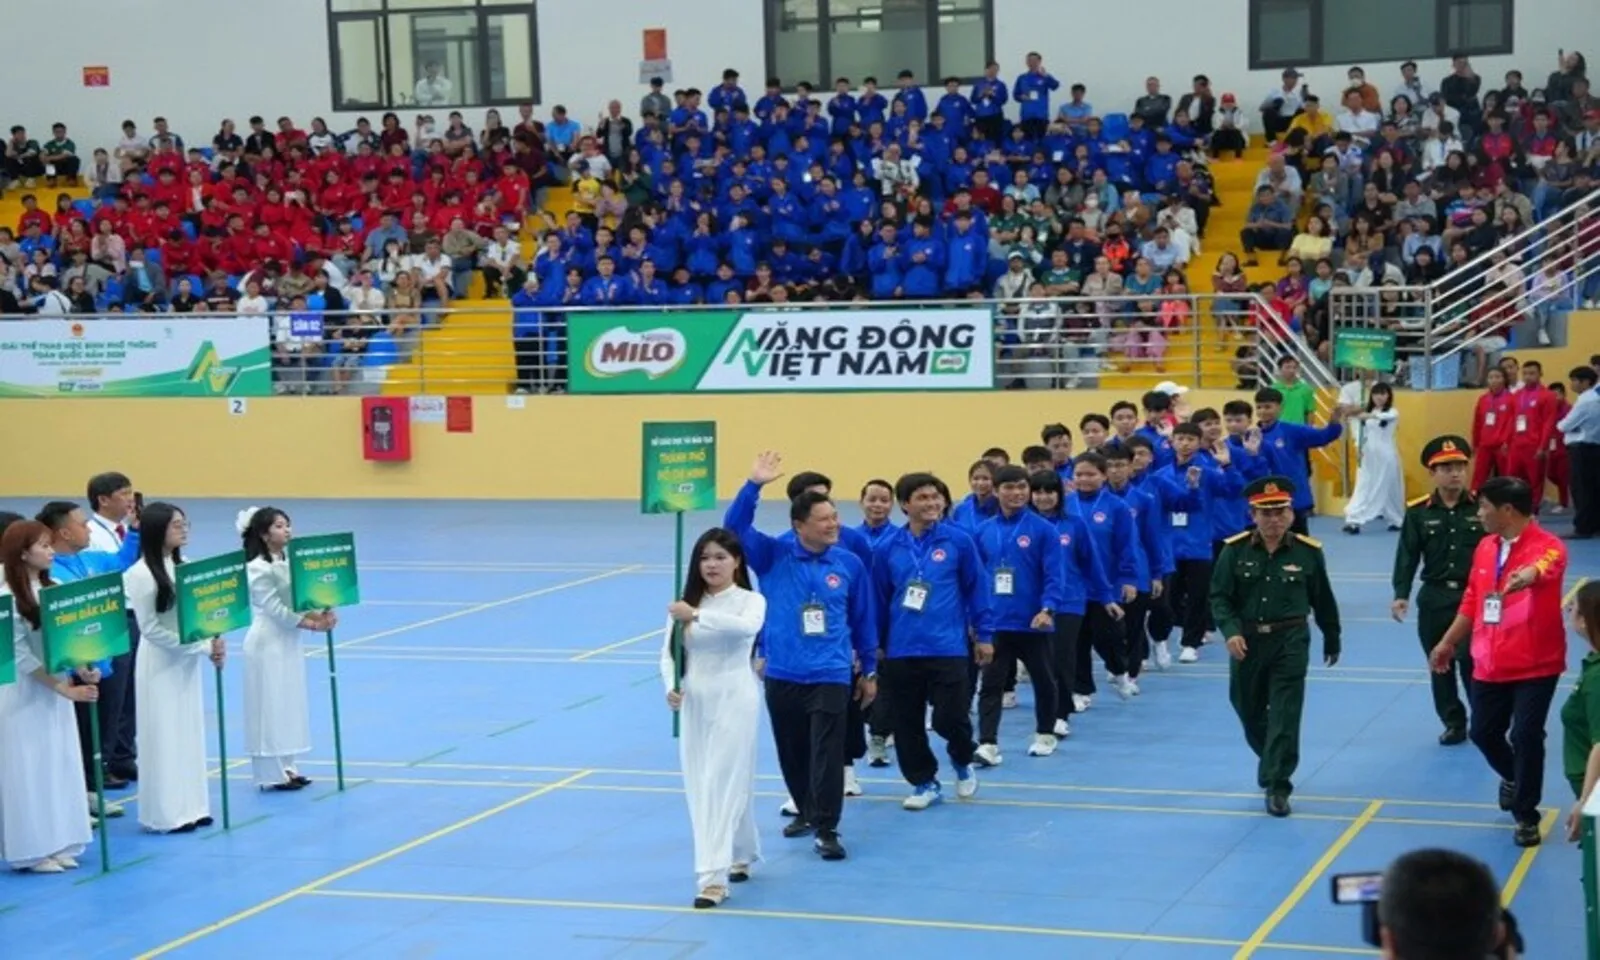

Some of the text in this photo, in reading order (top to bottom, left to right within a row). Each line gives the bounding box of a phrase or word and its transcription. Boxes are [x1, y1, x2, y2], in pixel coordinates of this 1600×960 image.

[601, 342, 675, 363] MILO
[723, 320, 848, 364] NĂNG
[742, 344, 928, 381] VIỆT NAM
[234, 400, 242, 413] 2
